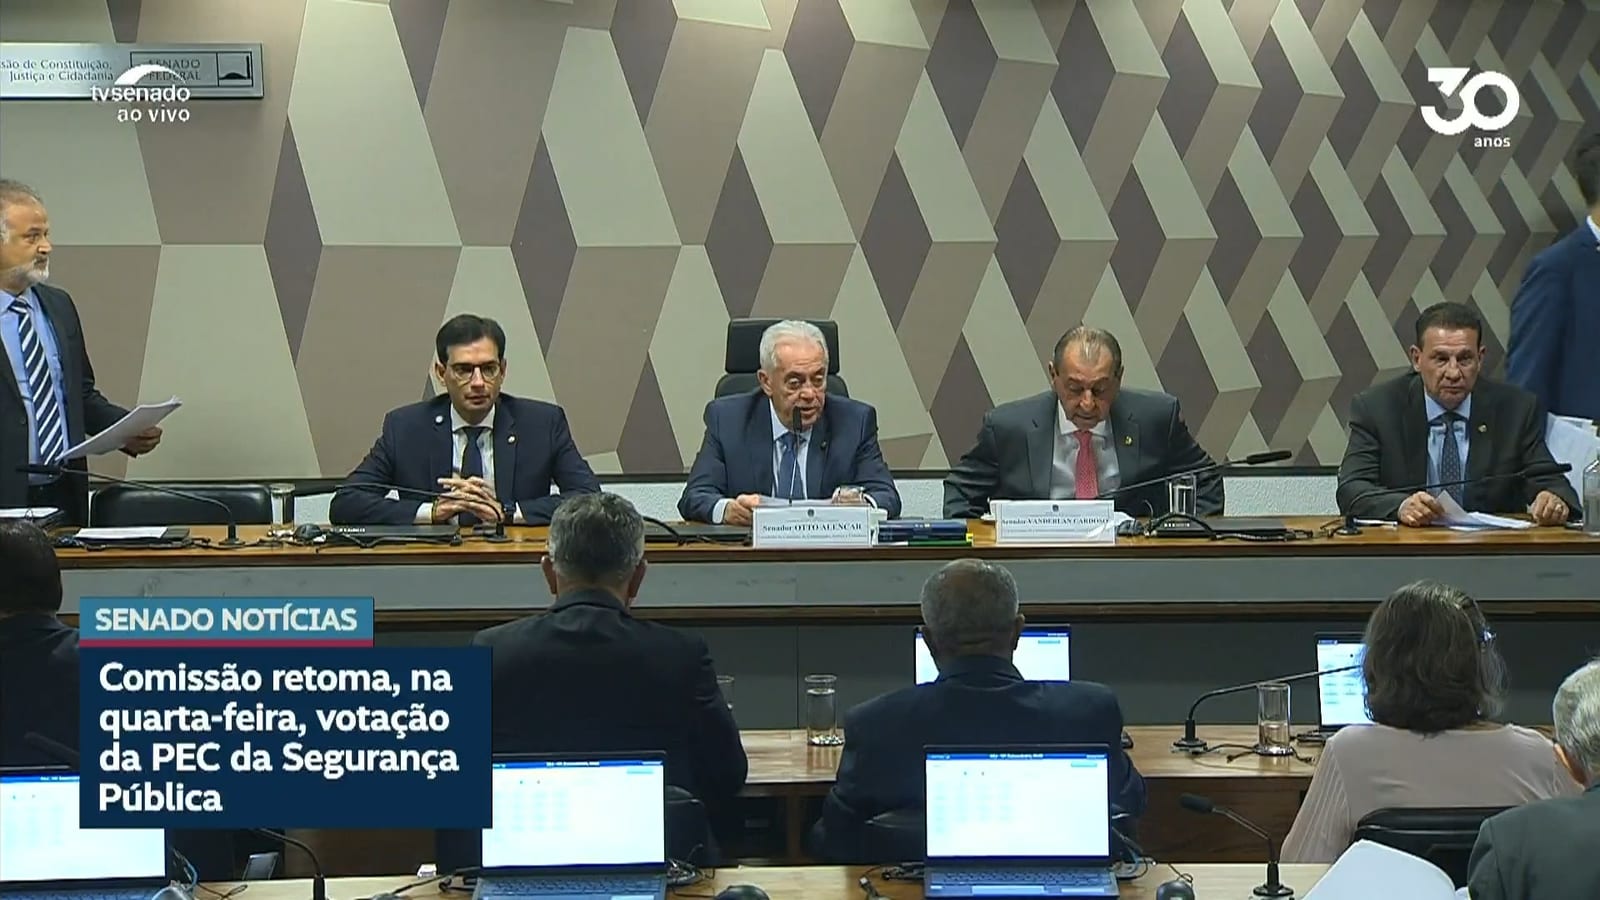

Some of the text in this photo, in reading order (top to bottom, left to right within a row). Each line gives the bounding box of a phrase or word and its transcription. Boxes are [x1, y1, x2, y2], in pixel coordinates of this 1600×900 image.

[23, 59, 37, 69] de
[40, 58, 113, 71] Constituição,
[10, 70, 114, 83] Justiça e Cidadania
[762, 522, 862, 532] Senador OTTO ALENCAR
